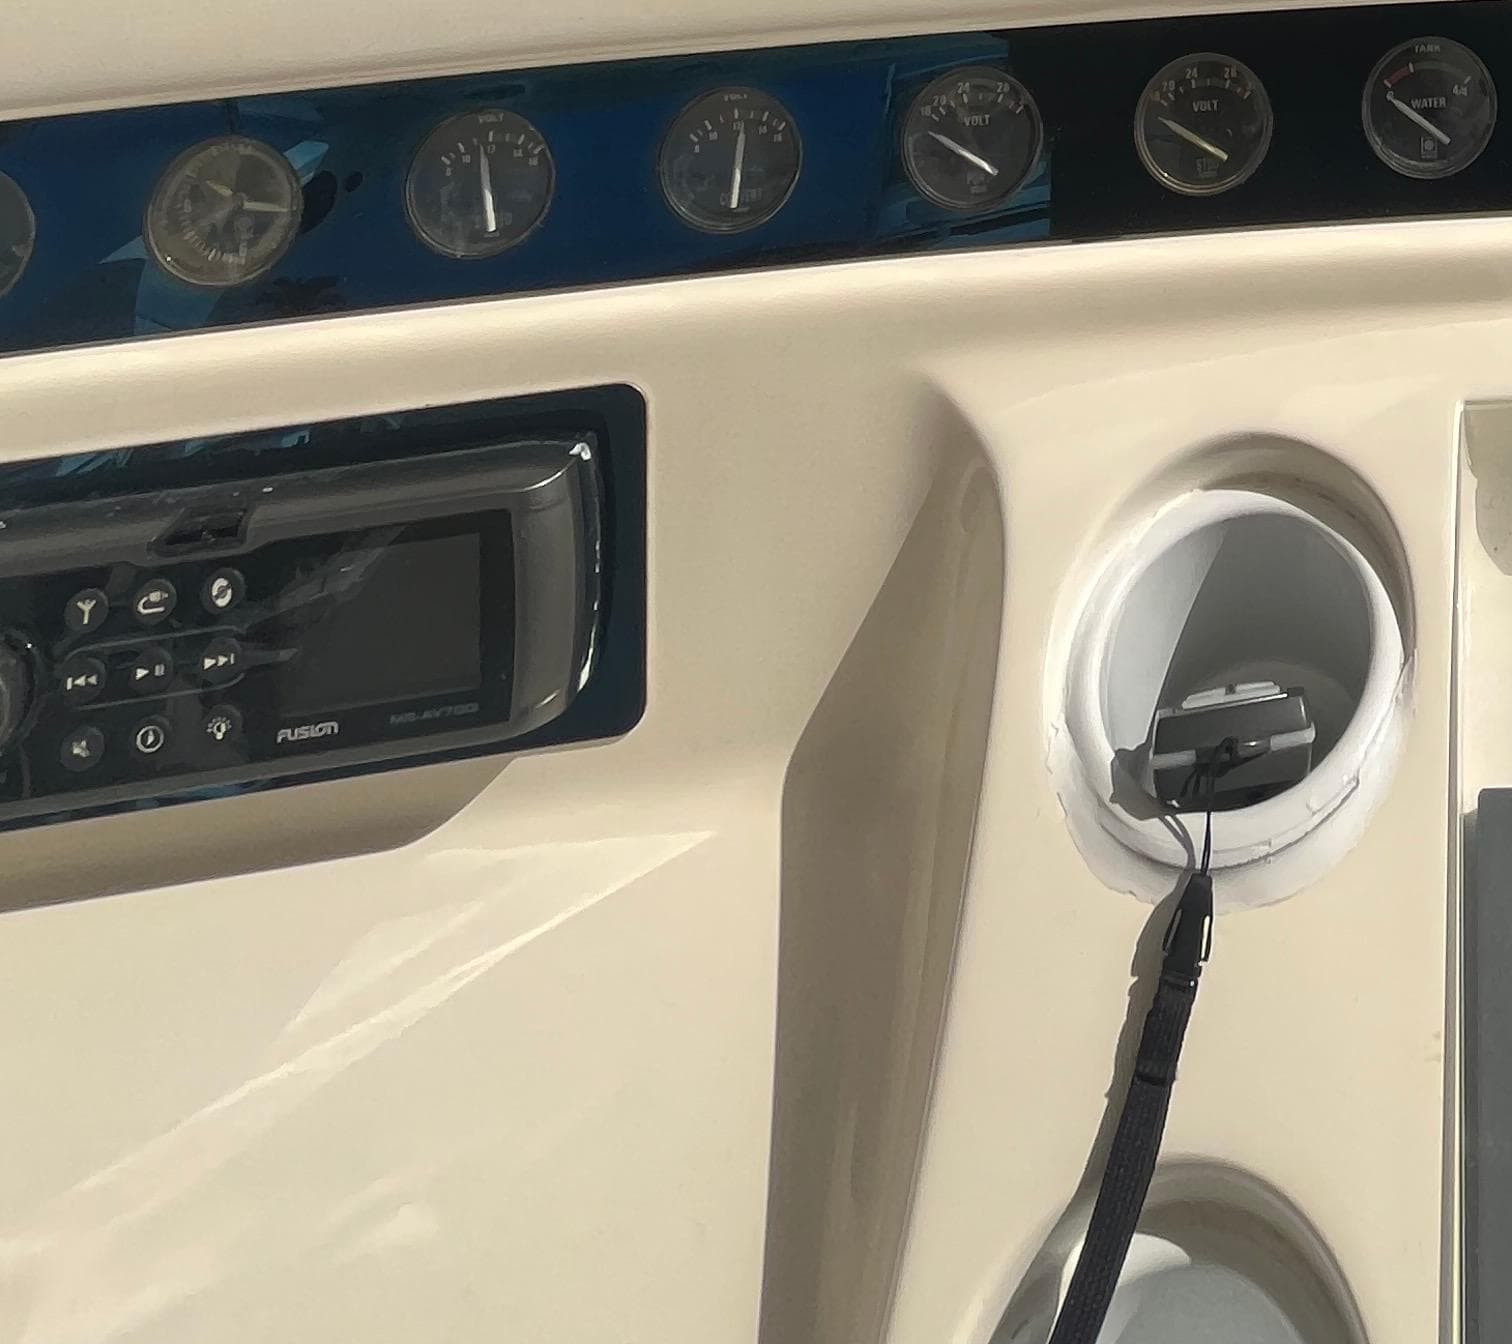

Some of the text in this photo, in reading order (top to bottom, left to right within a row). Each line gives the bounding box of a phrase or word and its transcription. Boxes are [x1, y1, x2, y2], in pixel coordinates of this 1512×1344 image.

[1414, 42, 1441, 54] TANK
[1185, 67, 1199, 80] 24
[1192, 98, 1220, 113] VOLT
[1410, 96, 1447, 110] WATER
[963, 114, 991, 127] VOLT
[276, 719, 340, 744] FUSION
